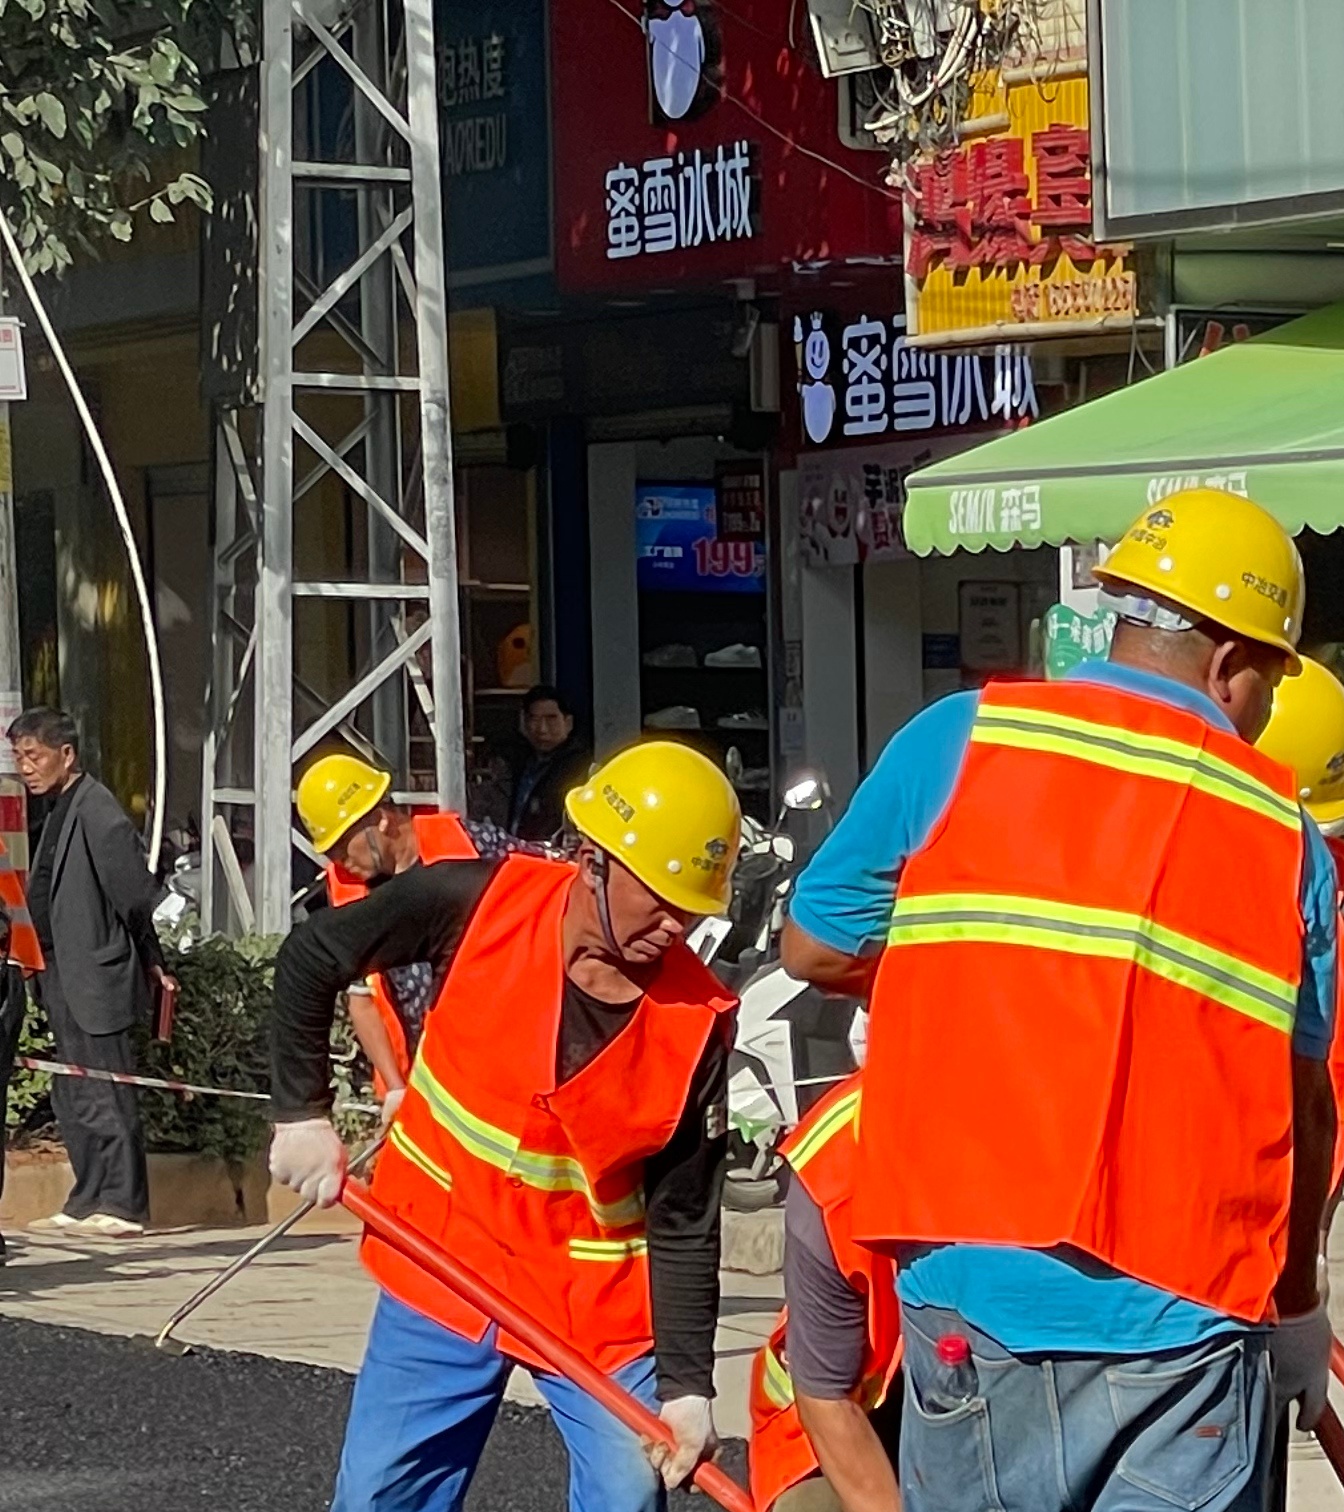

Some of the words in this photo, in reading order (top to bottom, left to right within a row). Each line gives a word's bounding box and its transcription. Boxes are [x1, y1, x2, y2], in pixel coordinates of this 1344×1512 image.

[441, 112, 507, 177] AOREDU
[606, 139, 753, 260] 蜜雪冰城
[1000, 485, 1042, 533] 森马
